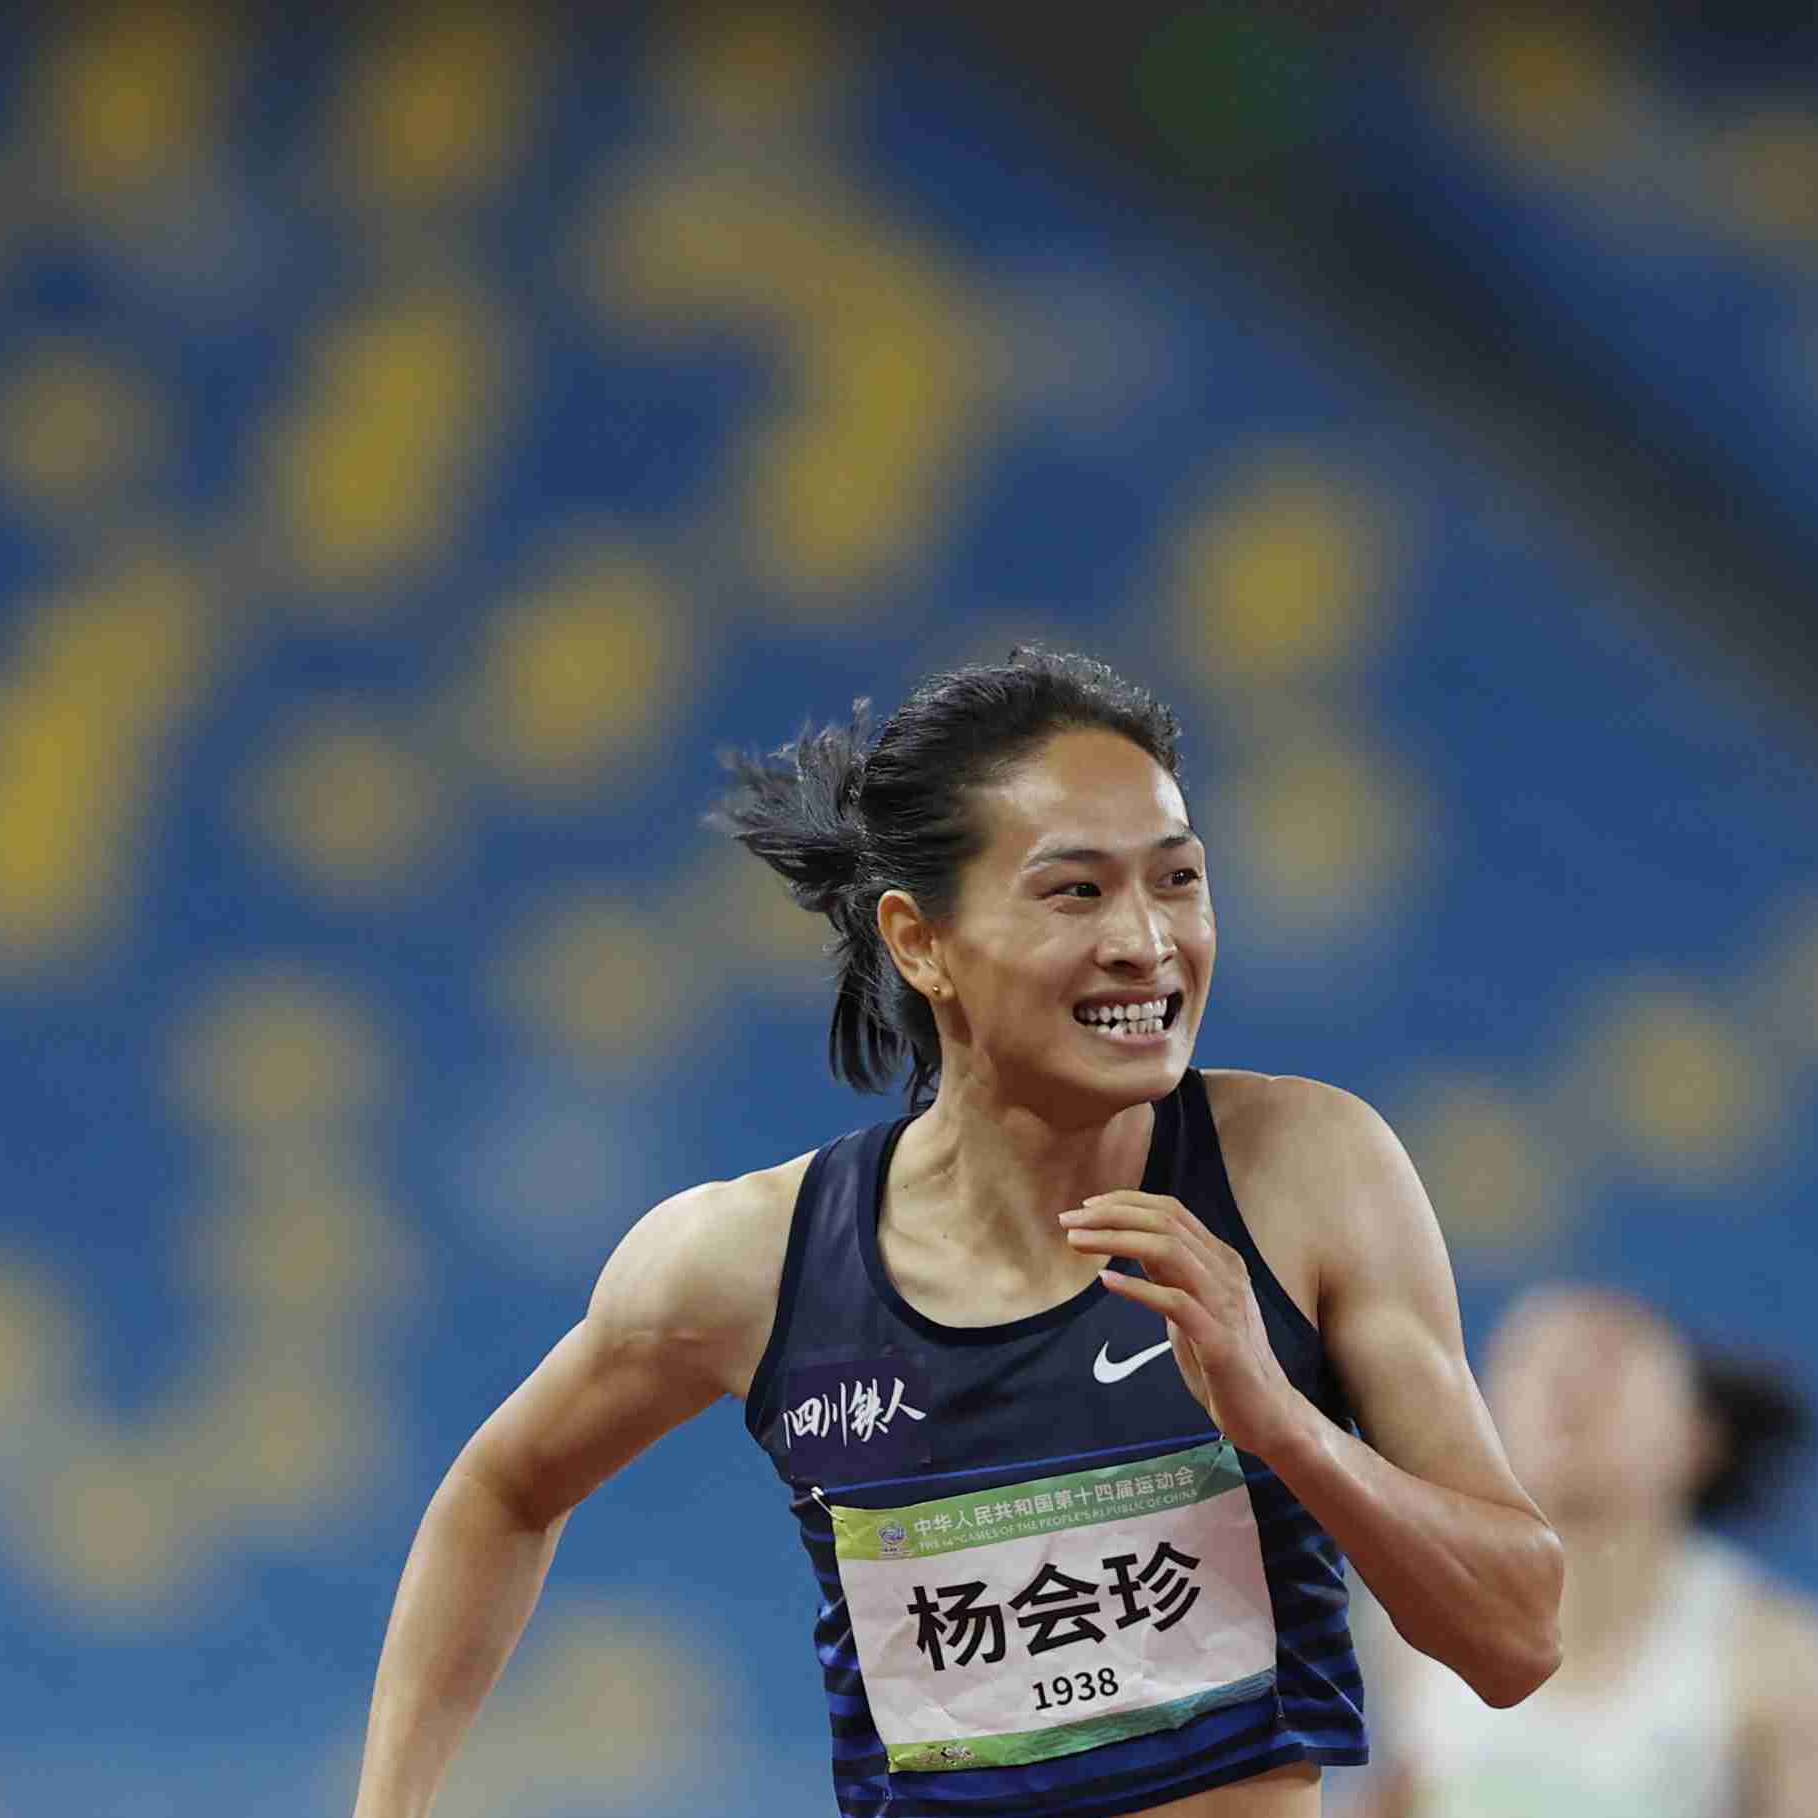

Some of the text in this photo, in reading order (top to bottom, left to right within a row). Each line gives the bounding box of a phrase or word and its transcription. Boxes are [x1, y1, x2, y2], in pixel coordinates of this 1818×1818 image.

[915, 1465, 1195, 1536] 中华人民共和国第十四届运动会
[1000, 1522, 1014, 1535] OF
[1018, 1517, 1038, 1532] THE
[907, 1541, 1201, 1671] 杨会珍
[1032, 1667, 1119, 1711] 1938
